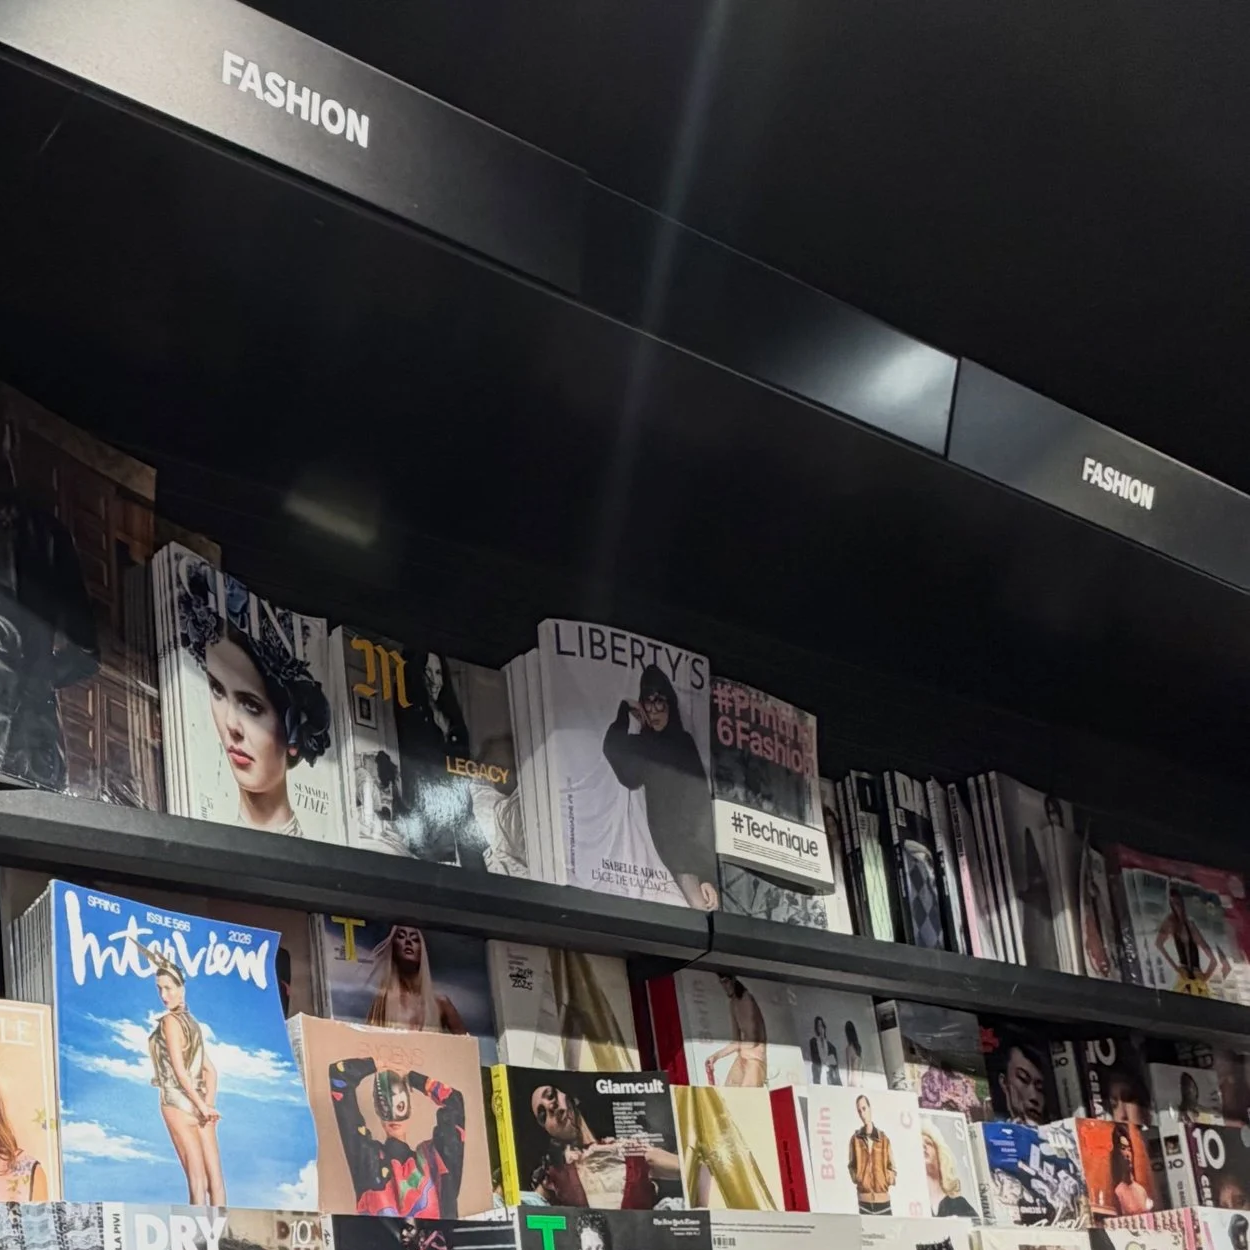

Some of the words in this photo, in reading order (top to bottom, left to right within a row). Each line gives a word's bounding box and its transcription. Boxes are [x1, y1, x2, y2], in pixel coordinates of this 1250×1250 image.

[222, 50, 369, 148] FASHION
[1082, 457, 1154, 510] FASHION
[554, 622, 707, 692] LIBERTY'S
[445, 755, 511, 785] LEGACY
[294, 794, 329, 817] TIME
[731, 810, 819, 858] #Technique
[87, 895, 121, 915] SPRING
[146, 912, 172, 930] ISSUE
[64, 890, 269, 990] Interview
[331, 915, 366, 962] T
[595, 1079, 665, 1095] Glamcult
[816, 1105, 837, 1181] Berlin
[1192, 1127, 1226, 1170] 10
[113, 1213, 122, 1237] PIVI
